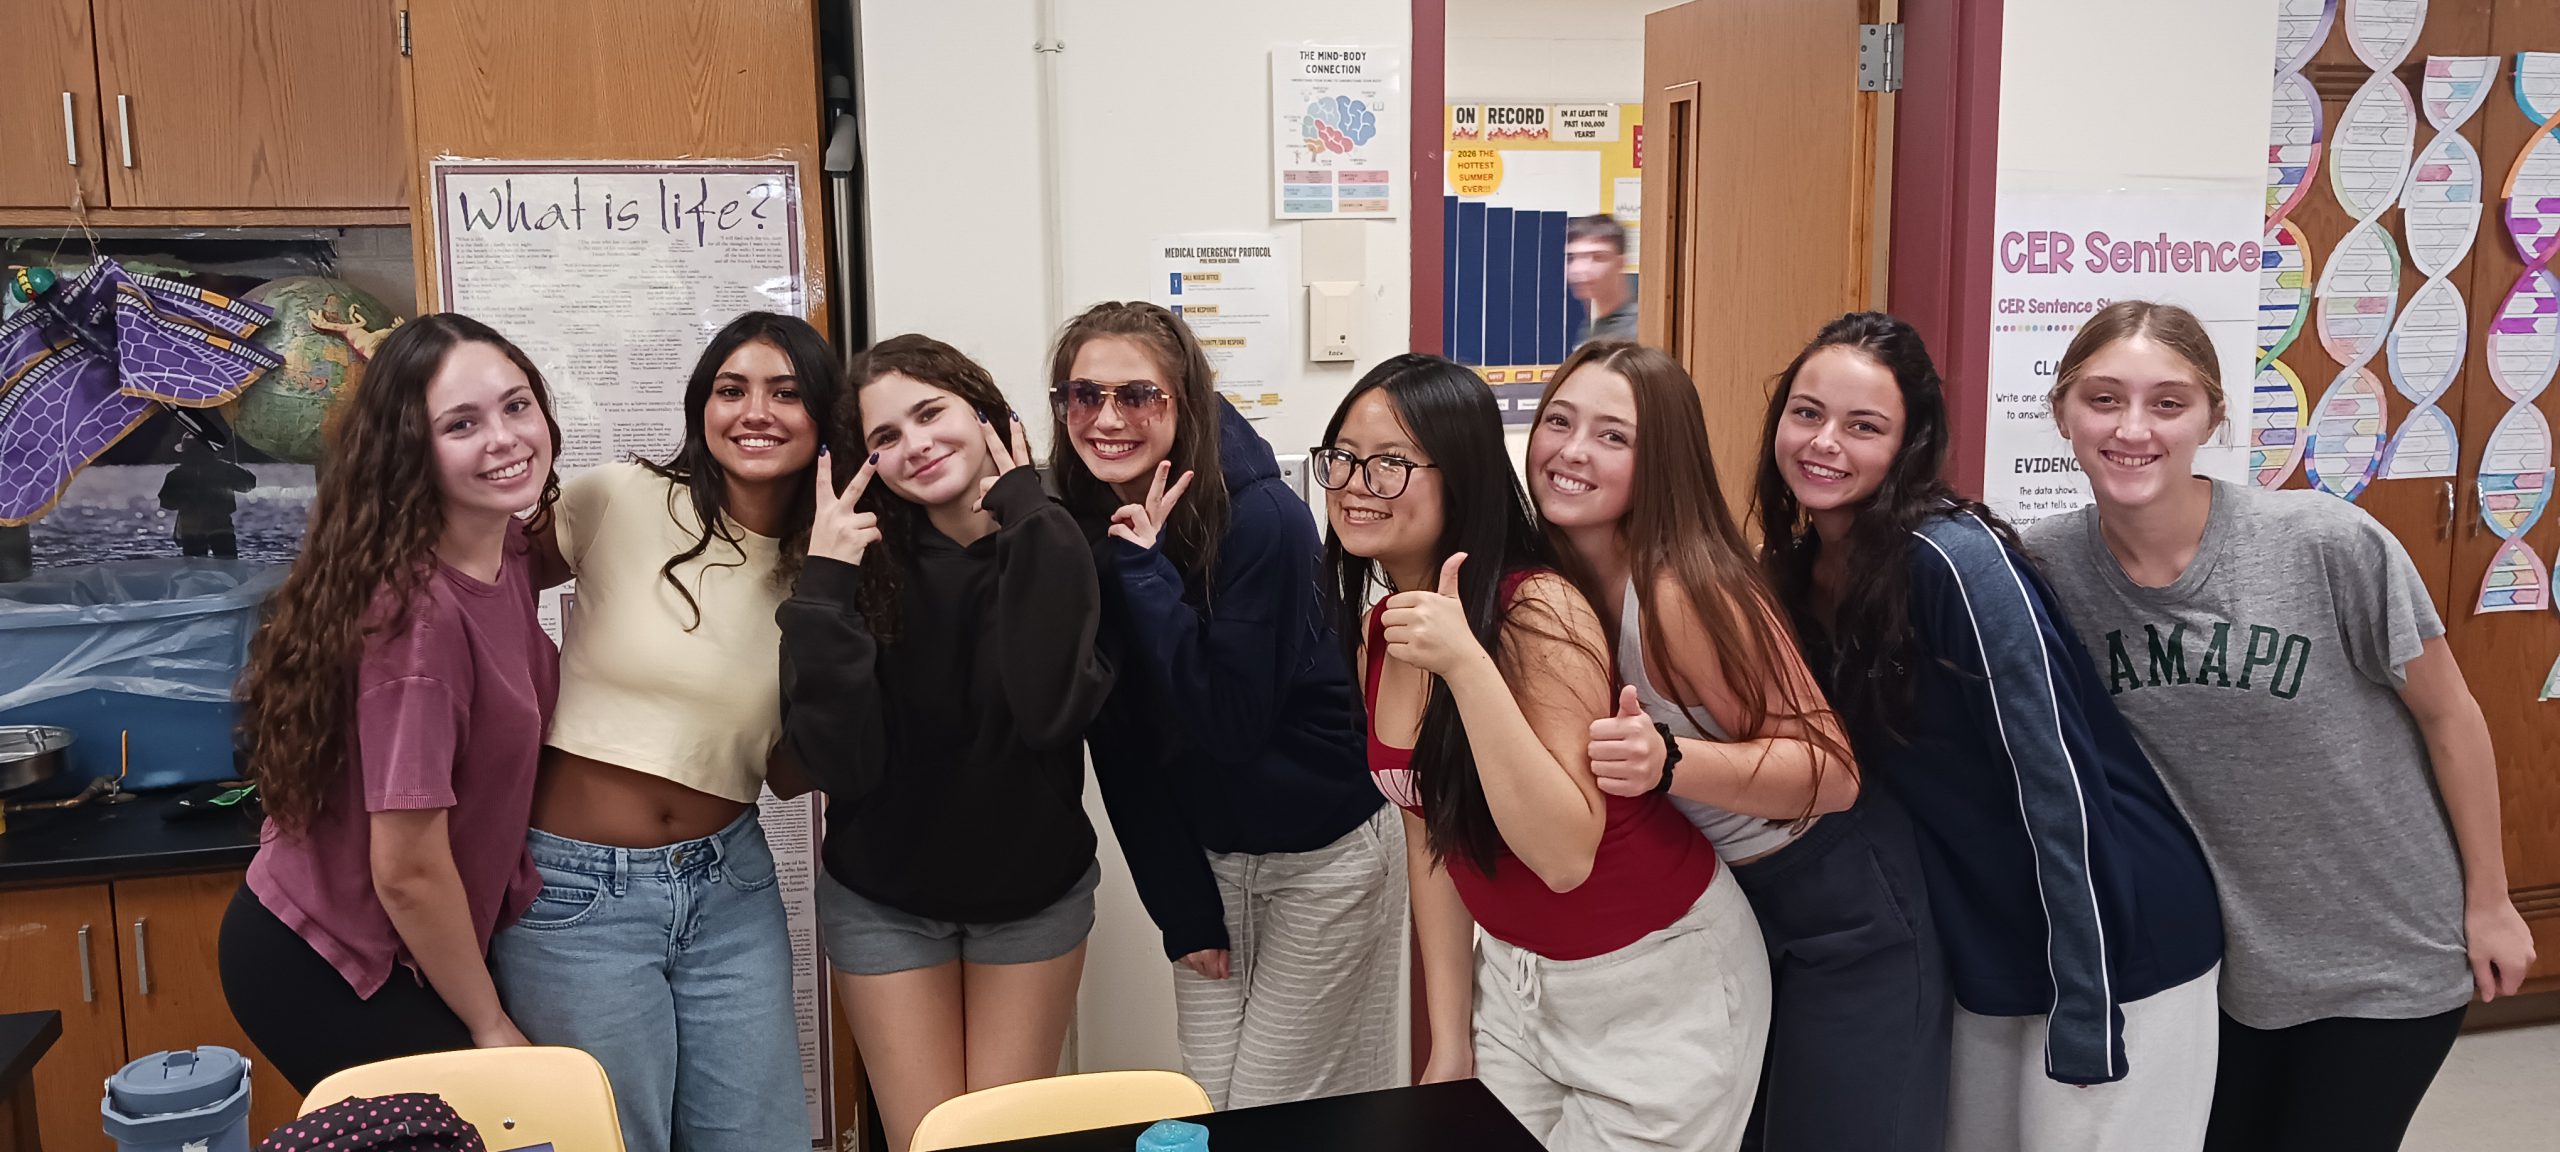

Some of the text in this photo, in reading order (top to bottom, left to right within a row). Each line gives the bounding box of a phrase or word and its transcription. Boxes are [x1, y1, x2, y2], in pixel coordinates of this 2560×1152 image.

[1299, 51, 1367, 61] THE MIND-BODY
[1305, 64, 1361, 74] CONNECTION
[1456, 107, 1545, 125] ON RECORD
[1578, 110, 1596, 118] LEAST
[1564, 120, 1578, 128] PAST
[1479, 150, 1495, 158] THE
[1459, 173, 1494, 181] SUMMER
[459, 176, 770, 248] What is life?
[1165, 246, 1272, 258] MEDICAL EMERGENCY PROTOCOL
[2000, 231, 2261, 274] CER Sentence
[1998, 298, 2025, 314] CER
[2028, 298, 2093, 314] Sentence
[1996, 393, 2018, 403] Write
[2021, 394, 2037, 403] one
[2007, 410, 2049, 419] to answer
[2014, 457, 2083, 474] EVIDENC
[2019, 486, 2032, 495] The
[2034, 486, 2053, 495] data
[2019, 501, 2031, 510] The
[2034, 501, 2049, 510] text
[2051, 500, 2067, 509] tells
[2105, 621, 2312, 700] AMAPO
